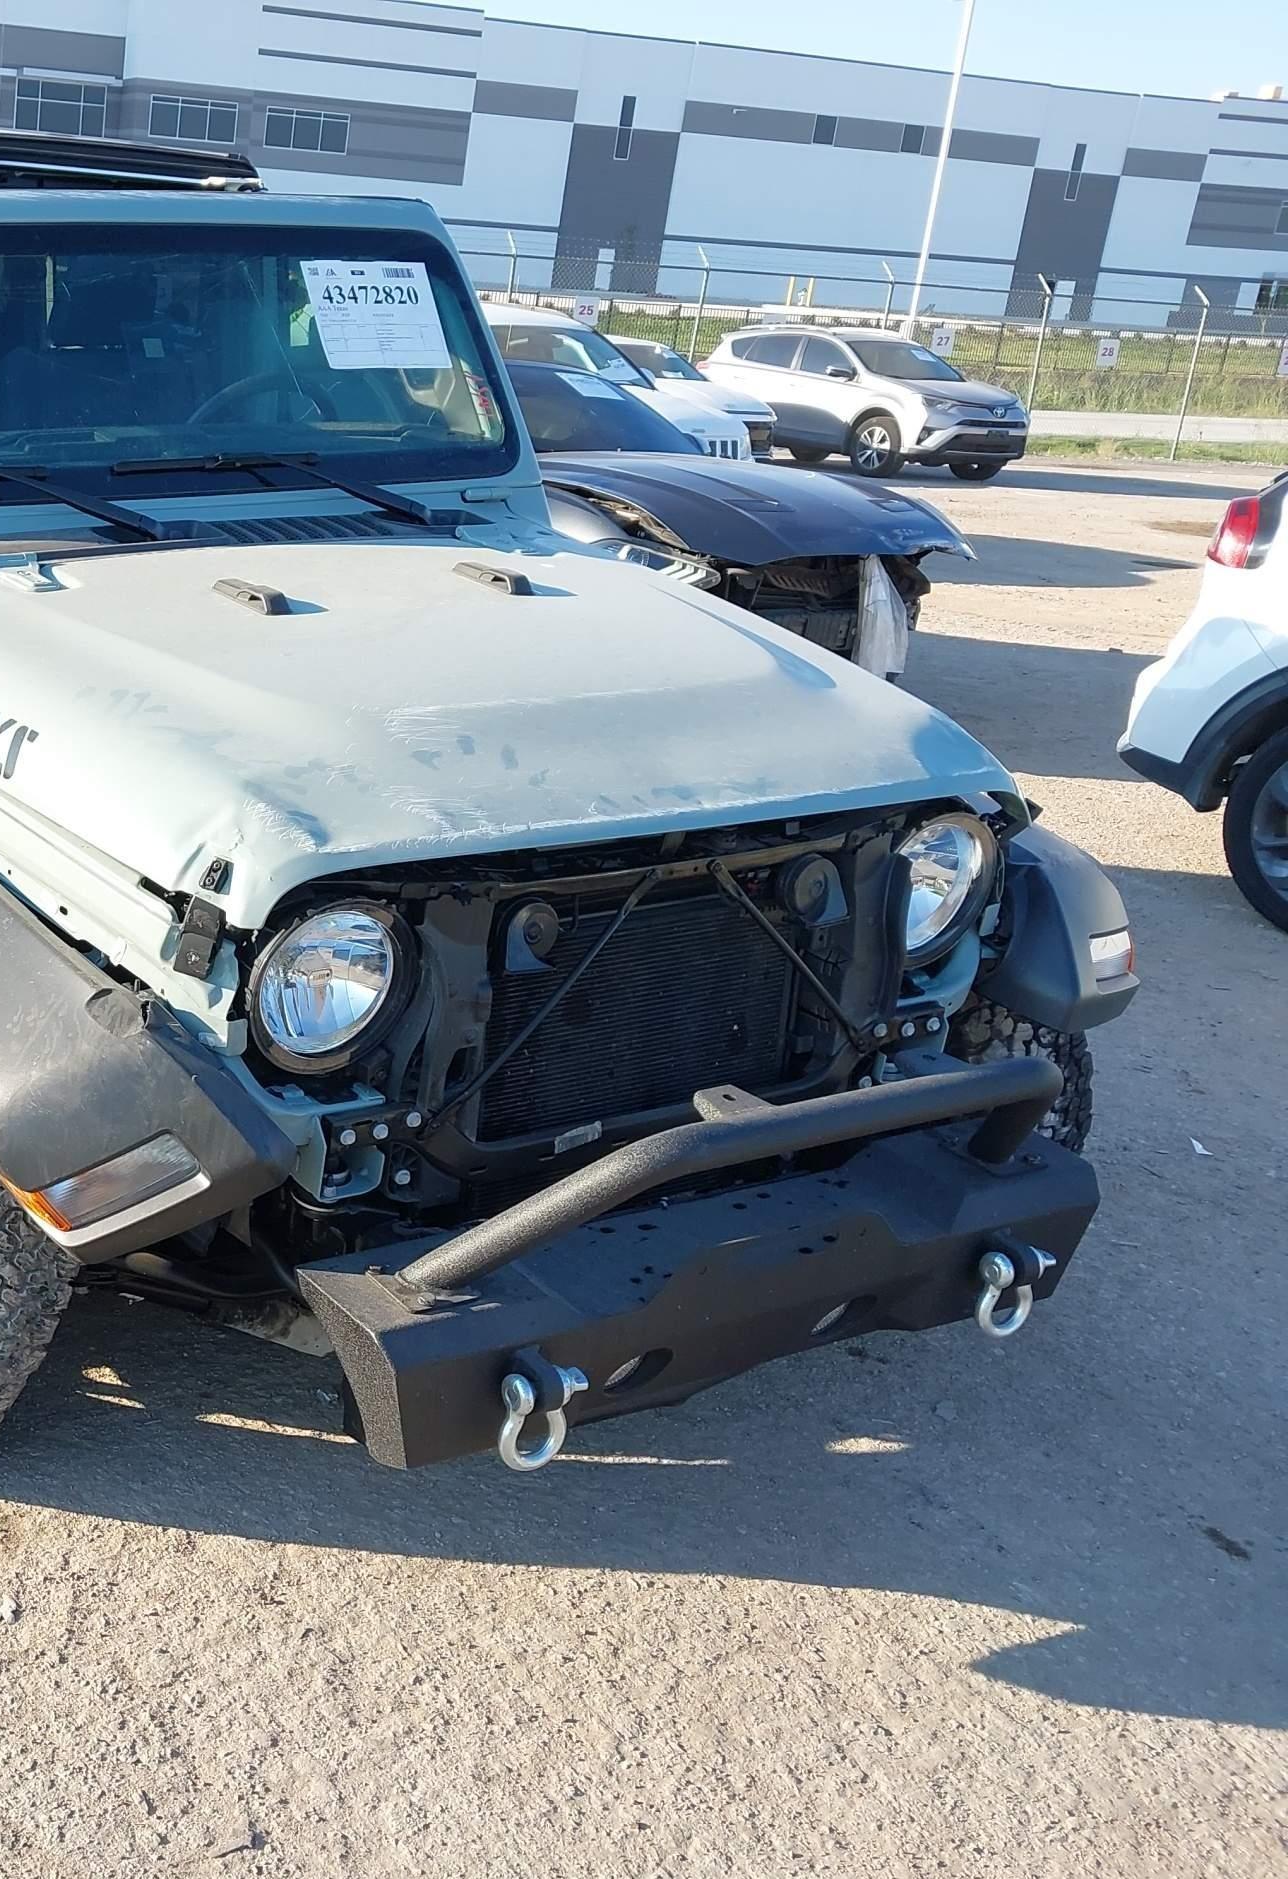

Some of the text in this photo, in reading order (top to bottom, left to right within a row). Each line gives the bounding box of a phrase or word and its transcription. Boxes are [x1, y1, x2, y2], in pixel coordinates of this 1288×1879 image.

[322, 284, 419, 305] 43472820
[578, 304, 594, 316] 25
[936, 336, 950, 347] 27
[1101, 347, 1114, 357] 28
